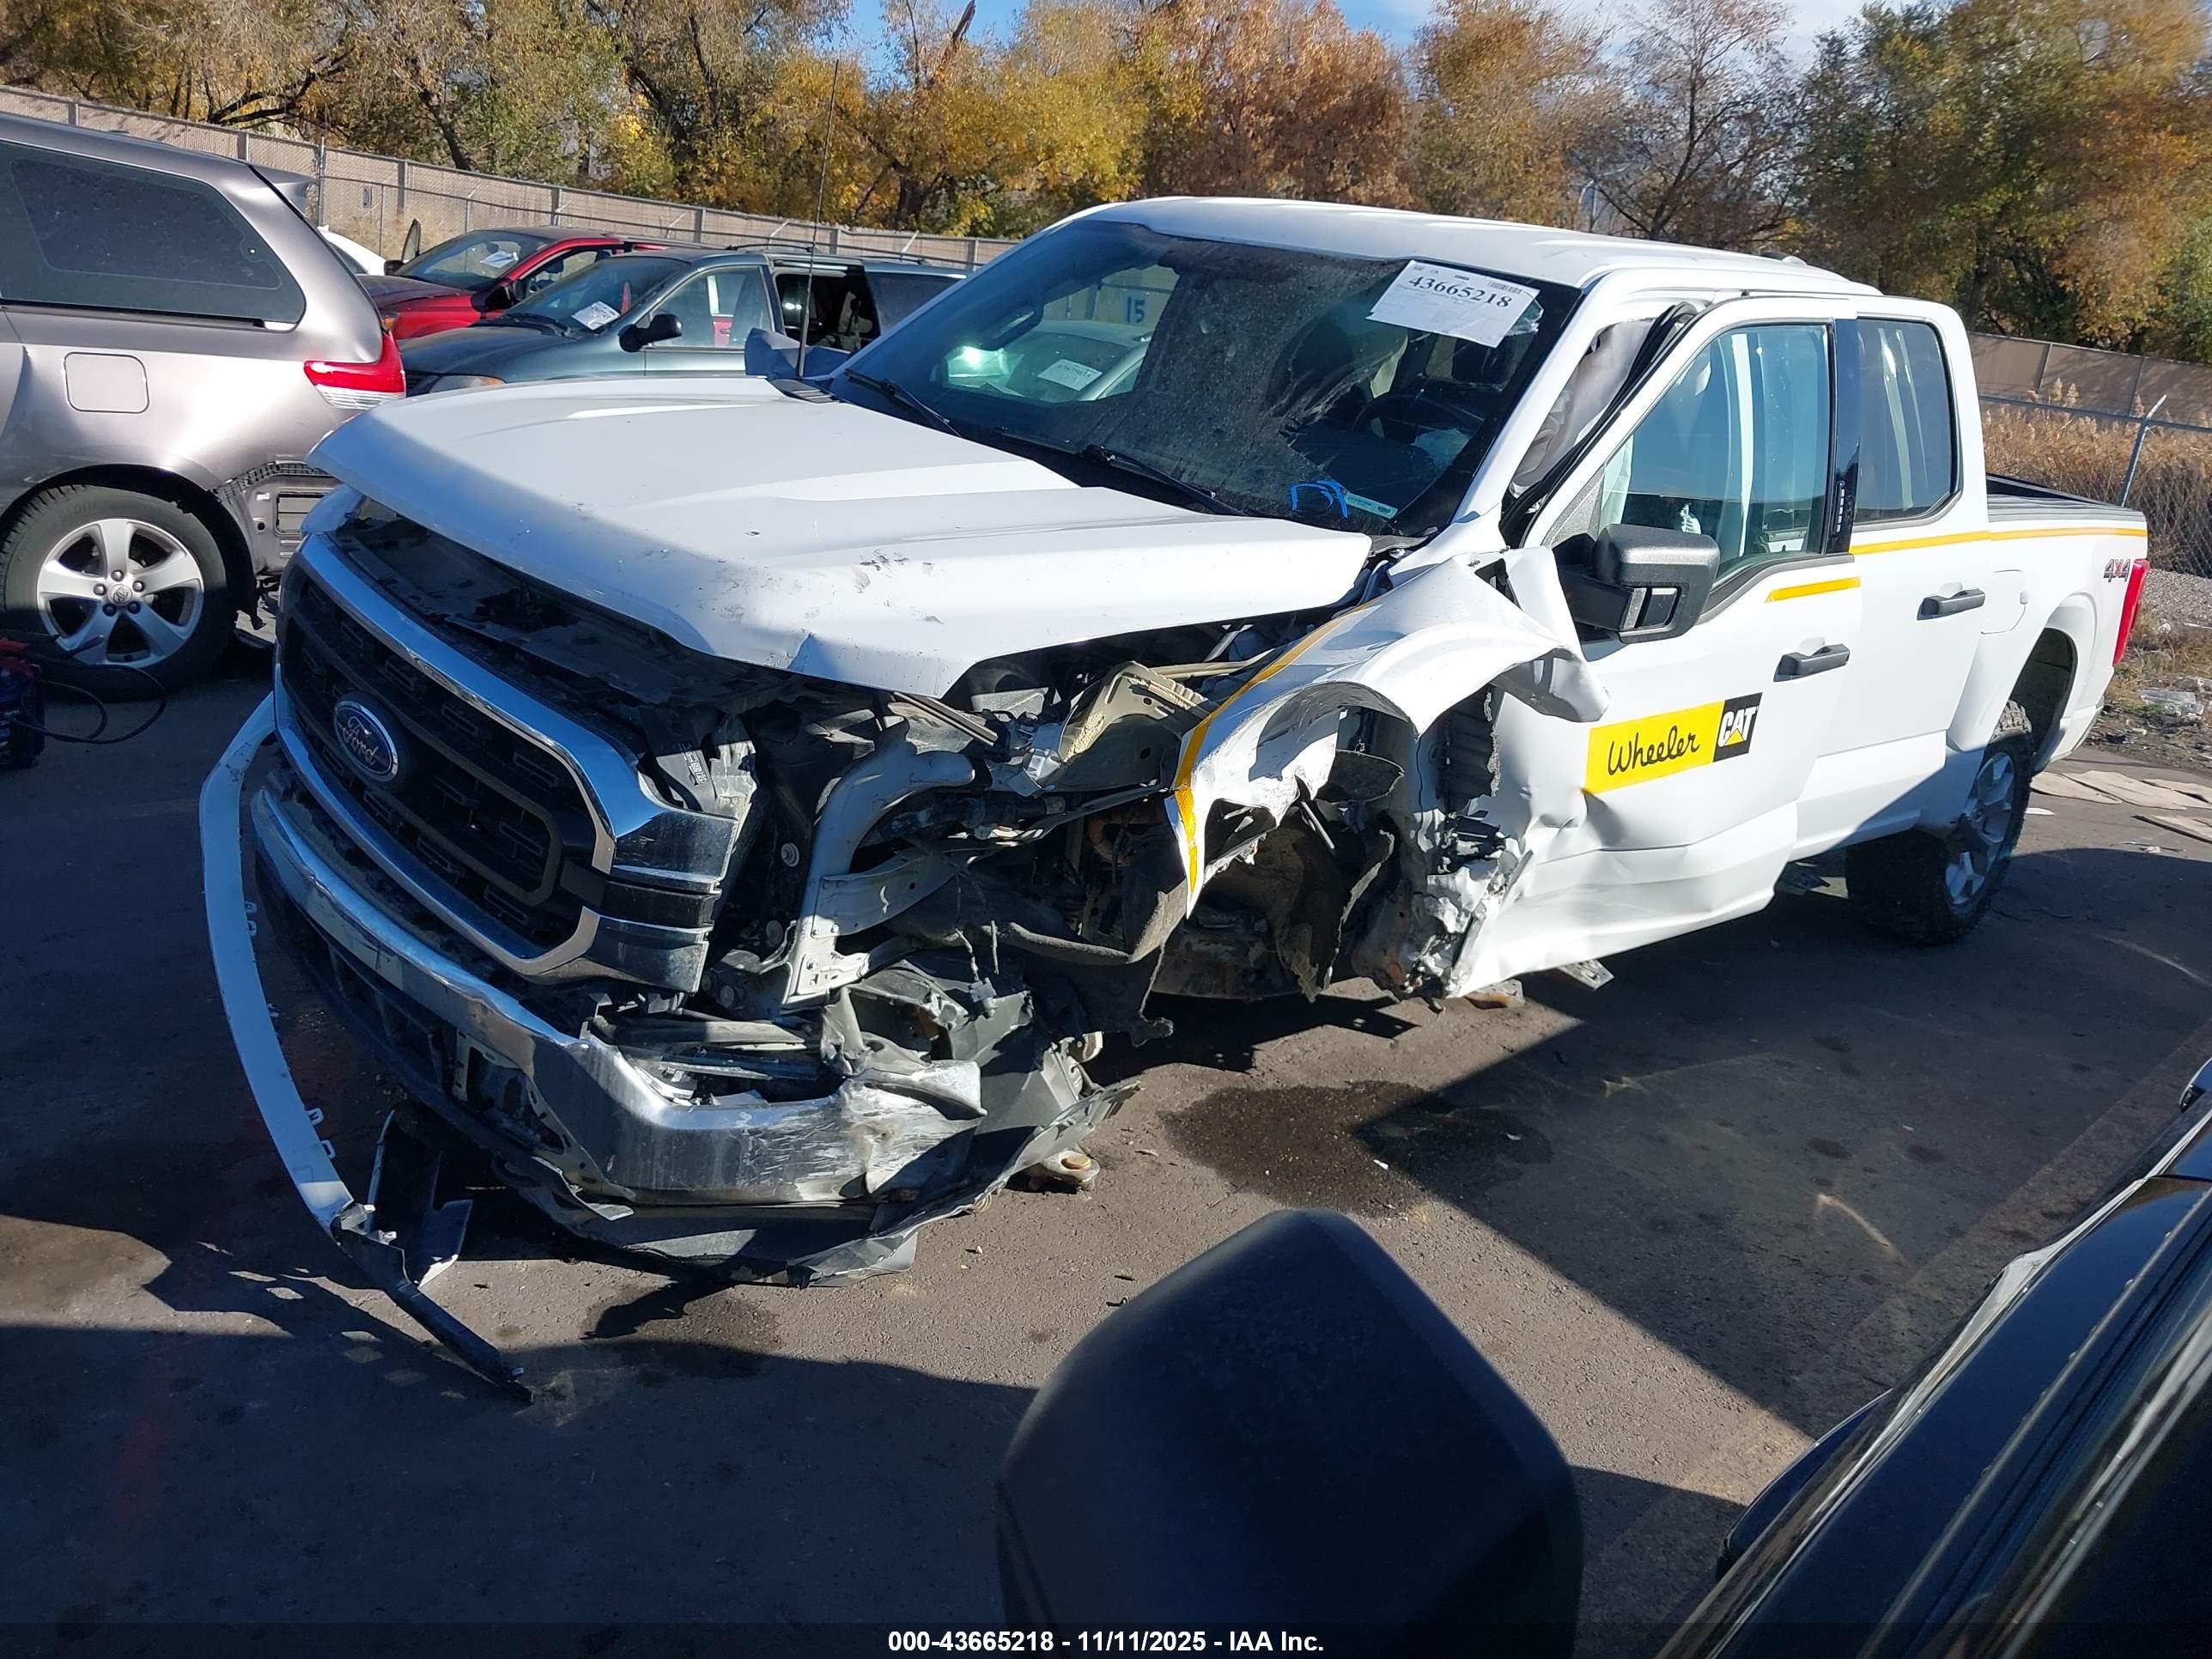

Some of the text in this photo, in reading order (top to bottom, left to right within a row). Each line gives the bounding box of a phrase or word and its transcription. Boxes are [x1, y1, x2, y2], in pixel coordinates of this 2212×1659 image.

[1127, 296, 1146, 323] 15
[1408, 276, 1512, 307] 43665218
[337, 715, 379, 766] Ford
[1607, 707, 1756, 776] Wheeler CAT
